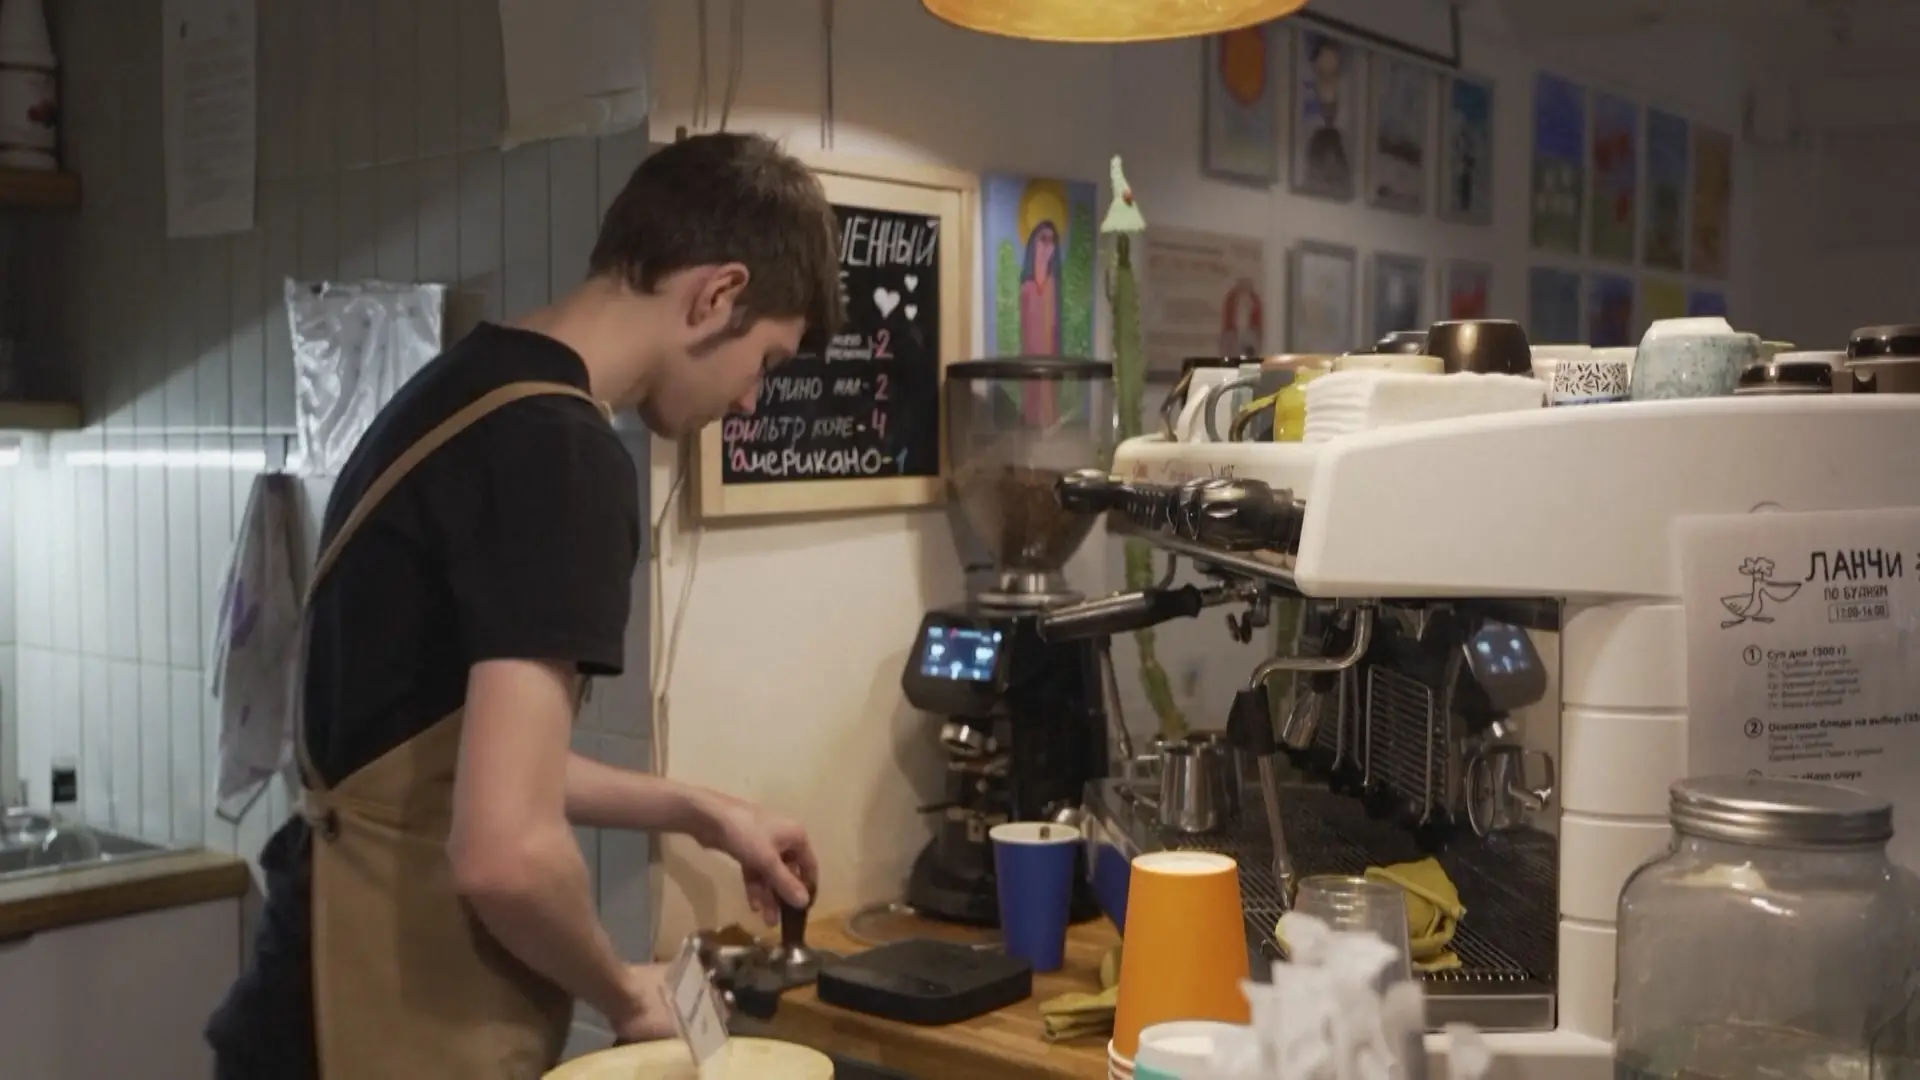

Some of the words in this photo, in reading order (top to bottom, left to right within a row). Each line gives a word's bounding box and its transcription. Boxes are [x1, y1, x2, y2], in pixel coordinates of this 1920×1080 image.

[839, 215, 938, 267] ЕННЫЙ
[759, 376, 823, 406] учино
[875, 373, 888, 401] 2
[871, 407, 888, 440] 4
[1805, 548, 1903, 582] ЛАНЧИ
[1824, 588, 1839, 600] ПО
[1843, 584, 1888, 600] БУДНЯМ
[1767, 650, 1786, 662] Суп
